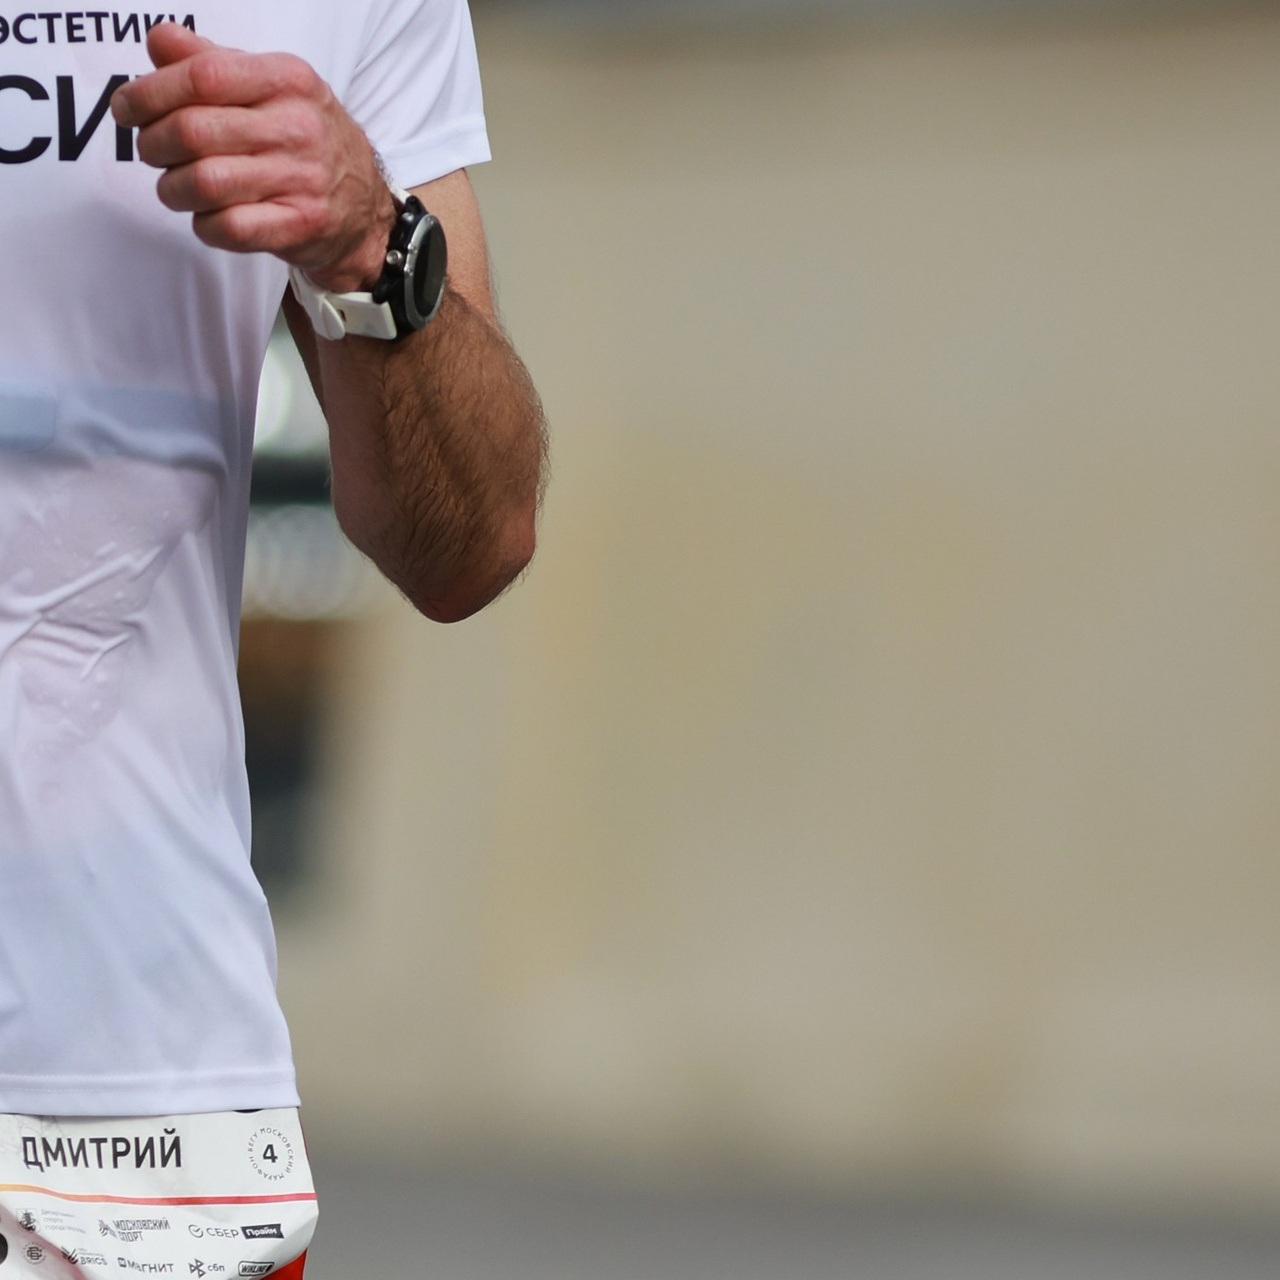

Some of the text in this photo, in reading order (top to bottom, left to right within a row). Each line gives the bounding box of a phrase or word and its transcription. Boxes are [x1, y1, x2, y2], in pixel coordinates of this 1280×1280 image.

[22, 1128, 182, 1172] ДМИТРИЙ
[259, 1127, 294, 1174] МОСКОВСКИЙ
[263, 1144, 278, 1163] 4
[249, 1156, 285, 1181] МАРАФОН
[113, 1217, 171, 1231] МОСКОВСКИЙ
[206, 1226, 278, 1238] СБЕР Прайм
[127, 1260, 174, 1273] МАГНИТ
[207, 1263, 225, 1272] сбп
